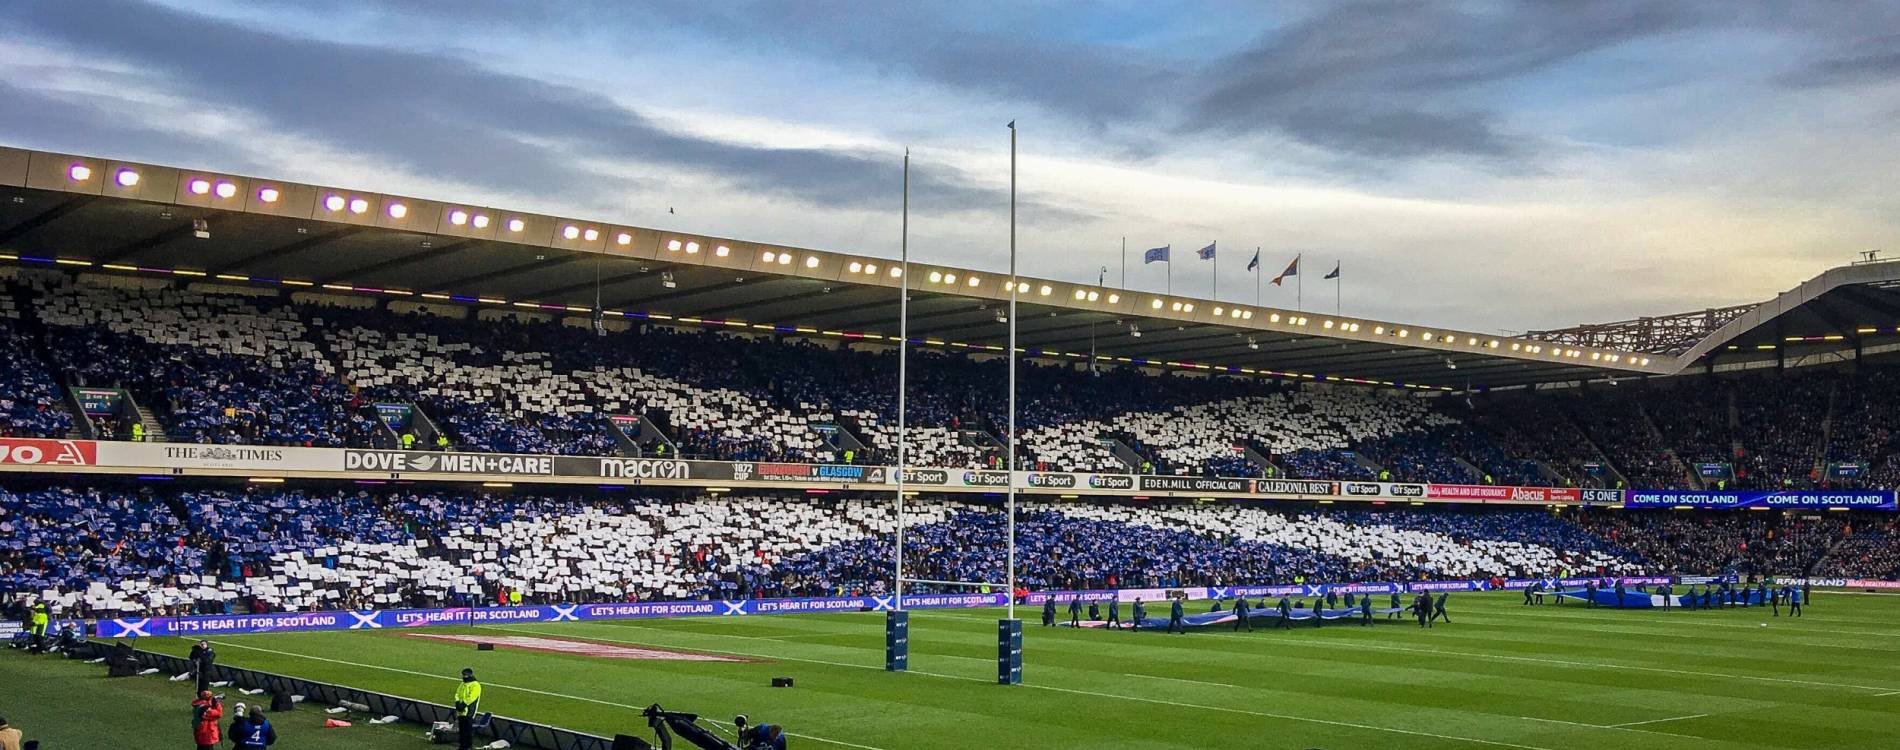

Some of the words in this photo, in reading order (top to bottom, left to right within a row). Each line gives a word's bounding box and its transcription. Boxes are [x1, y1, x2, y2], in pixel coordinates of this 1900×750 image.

[165, 447, 198, 459] THE
[236, 450, 282, 461] TIMES
[346, 452, 406, 470] DOVE
[440, 455, 550, 474] MEN+CARE
[600, 459, 690, 479] macron
[820, 466, 863, 477] GLASGOW
[902, 473, 915, 482] BT
[916, 472, 942, 483] Sport
[970, 474, 982, 483] BT
[984, 474, 1008, 484] Sport
[1048, 476, 1071, 486] Sport
[1108, 476, 1128, 487] Sport
[1145, 479, 1191, 489] EDEN.MILL
[1196, 481, 1227, 490] OFFICIAL
[1228, 482, 1241, 490] GIN
[1258, 481, 1308, 494] CALEDONIA
[1310, 483, 1330, 494] BEST
[1360, 486, 1377, 495] Sport
[1404, 486, 1420, 495] Sport
[1511, 488, 1544, 500] Abacus
[1582, 491, 1594, 500] AS
[1597, 491, 1618, 501] ONE
[1634, 494, 1660, 504] COME
[1662, 495, 1677, 504] ON
[1767, 495, 1799, 504] COME
[1802, 495, 1818, 504] ON
[591, 607, 613, 616] LET'S
[616, 606, 640, 615] HEAR
[642, 606, 650, 614] IT
[652, 605, 668, 614] FOR
[670, 604, 713, 613] SCOTLAND
[780, 602, 800, 610] HEAR
[397, 612, 424, 622] LET'S
[426, 611, 453, 622] HEAR
[456, 610, 466, 621] IT
[468, 610, 487, 620] FOR
[489, 609, 539, 619] SCOTLAND
[168, 620, 199, 631] LET'S
[202, 619, 235, 630] HEAR
[237, 618, 247, 628] IT
[251, 618, 274, 628] FOR
[276, 616, 335, 627] SCOTLAND
[251, 730, 260, 741] 4
